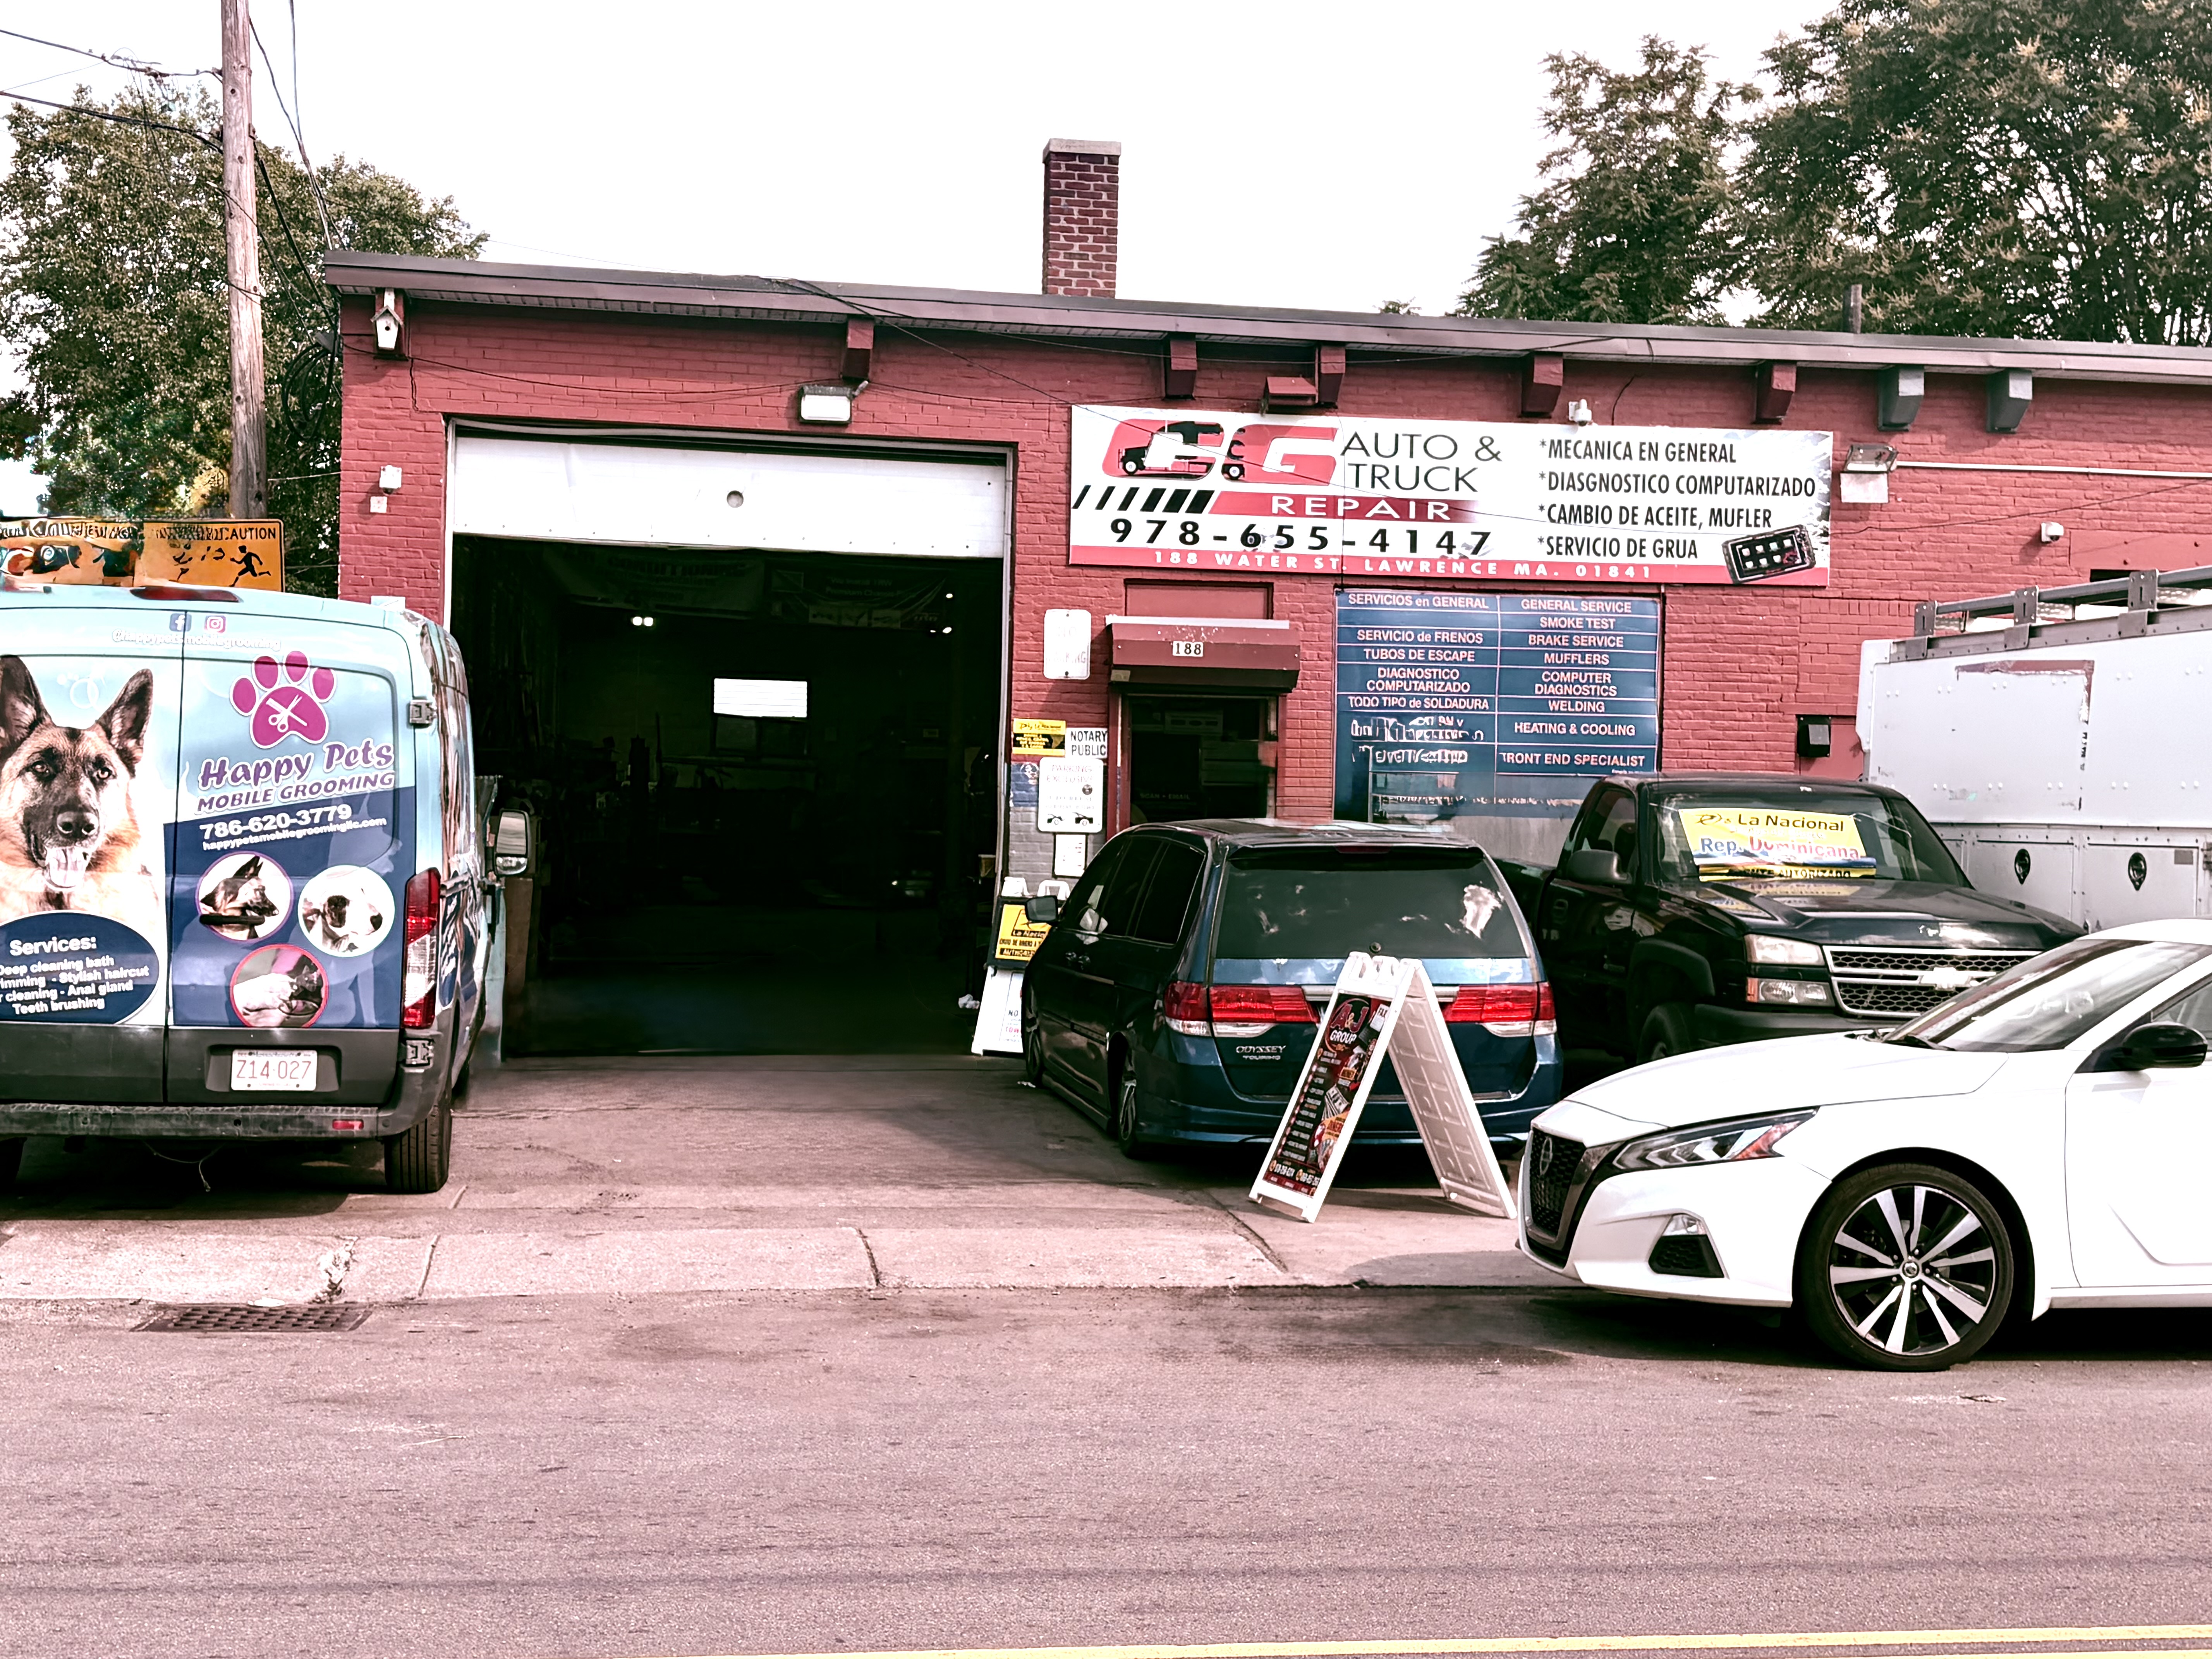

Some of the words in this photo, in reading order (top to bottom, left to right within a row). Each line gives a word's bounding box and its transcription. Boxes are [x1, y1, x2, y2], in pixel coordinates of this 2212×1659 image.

[1341, 431, 1458, 460] AUTO
[1475, 436, 1503, 462] &
[1639, 442, 1659, 462] EN
[1665, 442, 1736, 464] GENERAL
[1348, 463, 1478, 492] TRUCK
[1676, 475, 1816, 498] COMPUTARIZADO
[1272, 496, 1450, 520] REPAIR
[1619, 505, 1638, 525] DE
[1644, 506, 1703, 530] ACEITE,
[1708, 508, 1772, 528] MUFLER
[1110, 518, 1491, 555] 978-655-4147
[1627, 538, 1647, 558] DE
[1652, 539, 1698, 559] GRUA
[1156, 551, 1198, 565] 188
[1215, 553, 1297, 568] WATER
[1314, 557, 1346, 570] ST.
[1365, 559, 1497, 575] LAWRENCE
[1514, 563, 1559, 576] MA.
[1575, 564, 1650, 579] 01841
[1348, 594, 1412, 605] SERVICIOS
[1415, 598, 1429, 607] en
[1432, 596, 1489, 609] GENERAL
[1521, 599, 1578, 611] GENERAL
[1581, 601, 1632, 613] SERVICE
[1540, 617, 1584, 629] SMOKE
[1586, 618, 1616, 630] TEST
[1357, 629, 1414, 642] SERVICIO
[1417, 632, 1432, 642] de
[1434, 631, 1483, 644] FRENOS
[1528, 634, 1570, 646] BRAKE
[1572, 635, 1624, 648] SERVICE
[1175, 642, 1202, 655] 188
[1364, 649, 1405, 660] TUBOS
[1408, 649, 1425, 660] DE
[1428, 650, 1475, 662] ESCAPE
[1048, 651, 1086, 663] KING
[1544, 653, 1609, 665] MUFFLERS
[1377, 667, 1460, 680] DIAGNOSTICO
[1542, 671, 1611, 684] COMPUTER
[1367, 680, 1470, 693] COMPUTARIZADO
[1534, 684, 1618, 697] DIAGNOSTICS
[1350, 696, 1379, 708] TODO
[1381, 697, 1406, 708] TIPO
[1409, 697, 1422, 708] de
[1424, 697, 1489, 710] SOLDADURA
[1548, 700, 1605, 713] WELDING
[1070, 730, 1108, 742] NOTARY
[1514, 722, 1567, 734] HEATING
[1569, 723, 1578, 735] &
[1580, 723, 1635, 736] COOLING
[1071, 744, 1106, 756] PUBLIC
[199, 753, 314, 790] Happy
[323, 738, 395, 773] Pets
[1544, 753, 1571, 765] END
[1573, 754, 1645, 767] SPECIALIST
[196, 788, 275, 814] MOBILE
[280, 771, 395, 802] GROOMING
[199, 804, 352, 840] 786-620-3779
[1738, 814, 1759, 826] La
[1765, 815, 1844, 832] Nacional
[1700, 837, 1742, 855] Rep.
[10, 936, 97, 956] Services:
[30, 958, 84, 973] cleaning
[86, 955, 115, 968] bath
[0, 975, 46, 988] imming
[59, 969, 101, 984] Stylish
[104, 965, 149, 980] haircut
[5, 988, 58, 1002] cleaning
[67, 983, 95, 996] Anal
[98, 979, 134, 996] gland
[12, 1001, 48, 1015] Teeth
[50, 997, 105, 1012] brushing
[1329, 1029, 1357, 1044] GROUP
[1236, 1045, 1286, 1053] ODYSSEY
[236, 1060, 270, 1079] Z14
[278, 1060, 312, 1079] 027
